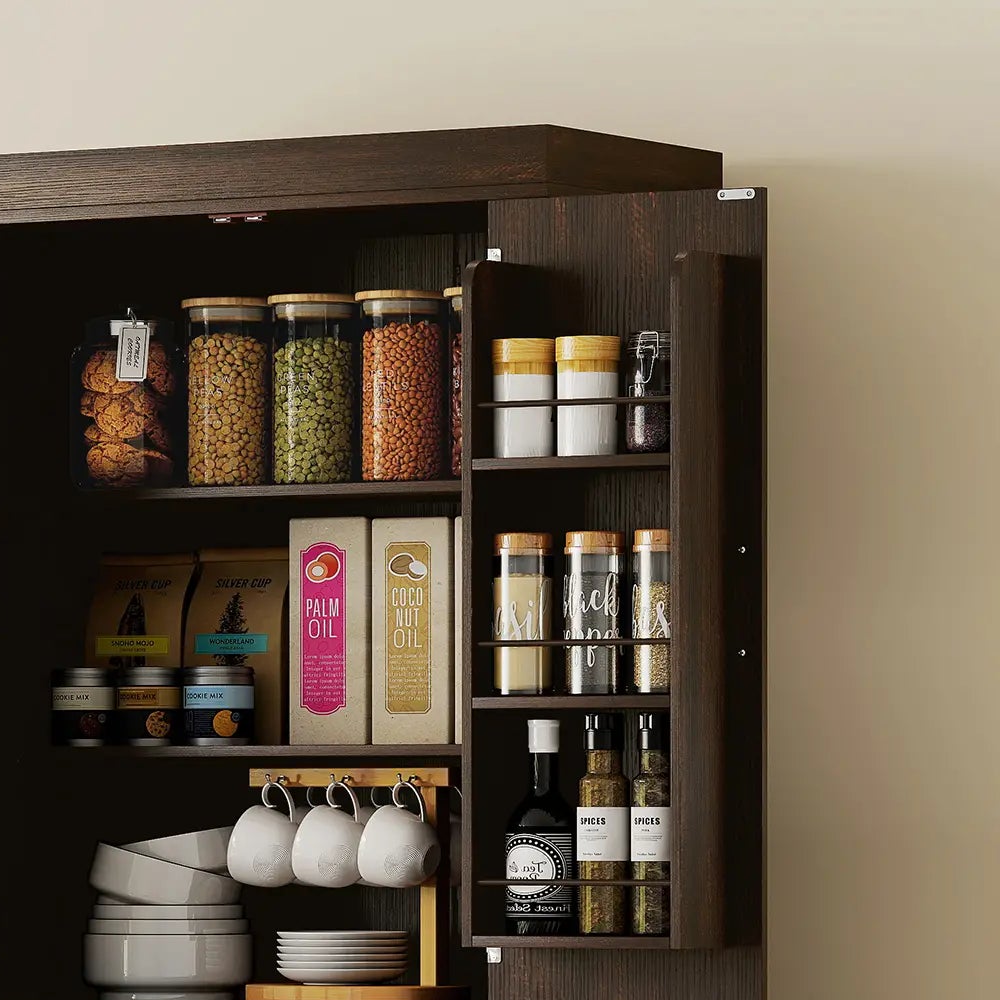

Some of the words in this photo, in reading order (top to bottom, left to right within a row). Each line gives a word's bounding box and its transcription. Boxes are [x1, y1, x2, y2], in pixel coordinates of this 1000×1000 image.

[191, 375, 233, 385] ELLOW
[194, 387, 222, 399] PEAS
[280, 384, 310, 395] PEAS
[151, 579, 172, 589] CUP
[216, 578, 249, 588] SILVER
[250, 578, 272, 588] CUP
[392, 587, 423, 606] COCO
[306, 598, 339, 617] PALM
[492, 579, 549, 640] asil
[396, 608, 419, 627] NUT
[308, 619, 337, 638] OIL
[393, 629, 422, 648] OIL
[186, 692, 208, 700] COOKIE
[580, 817, 606, 826] SPICES
[634, 817, 661, 826] SPICES
